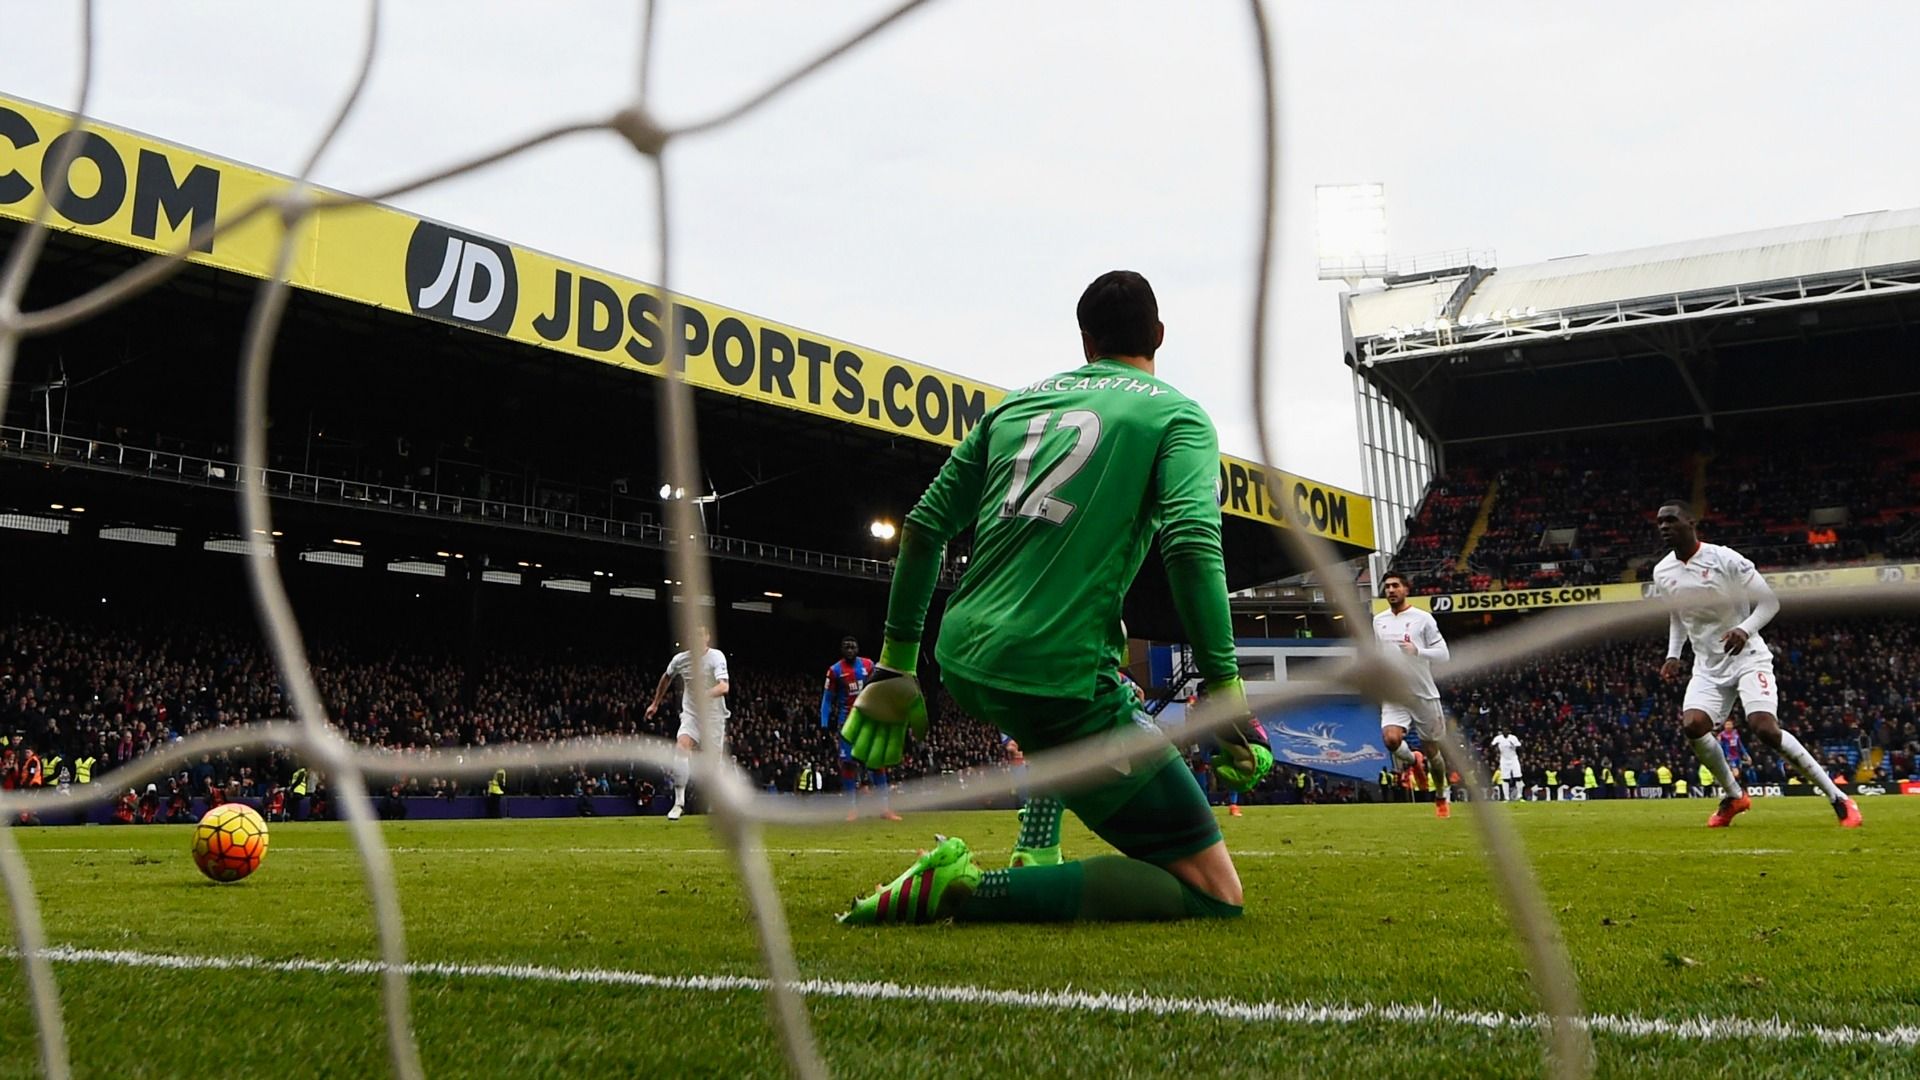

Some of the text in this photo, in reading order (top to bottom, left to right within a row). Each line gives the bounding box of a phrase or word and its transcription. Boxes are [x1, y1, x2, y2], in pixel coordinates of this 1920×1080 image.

[418, 236, 985, 440] JD JDSPORTS.COM
[998, 410, 1101, 526] 12
[1433, 588, 1601, 611] JD JDSPORTS.COM
[1756, 671, 1768, 688] 9
